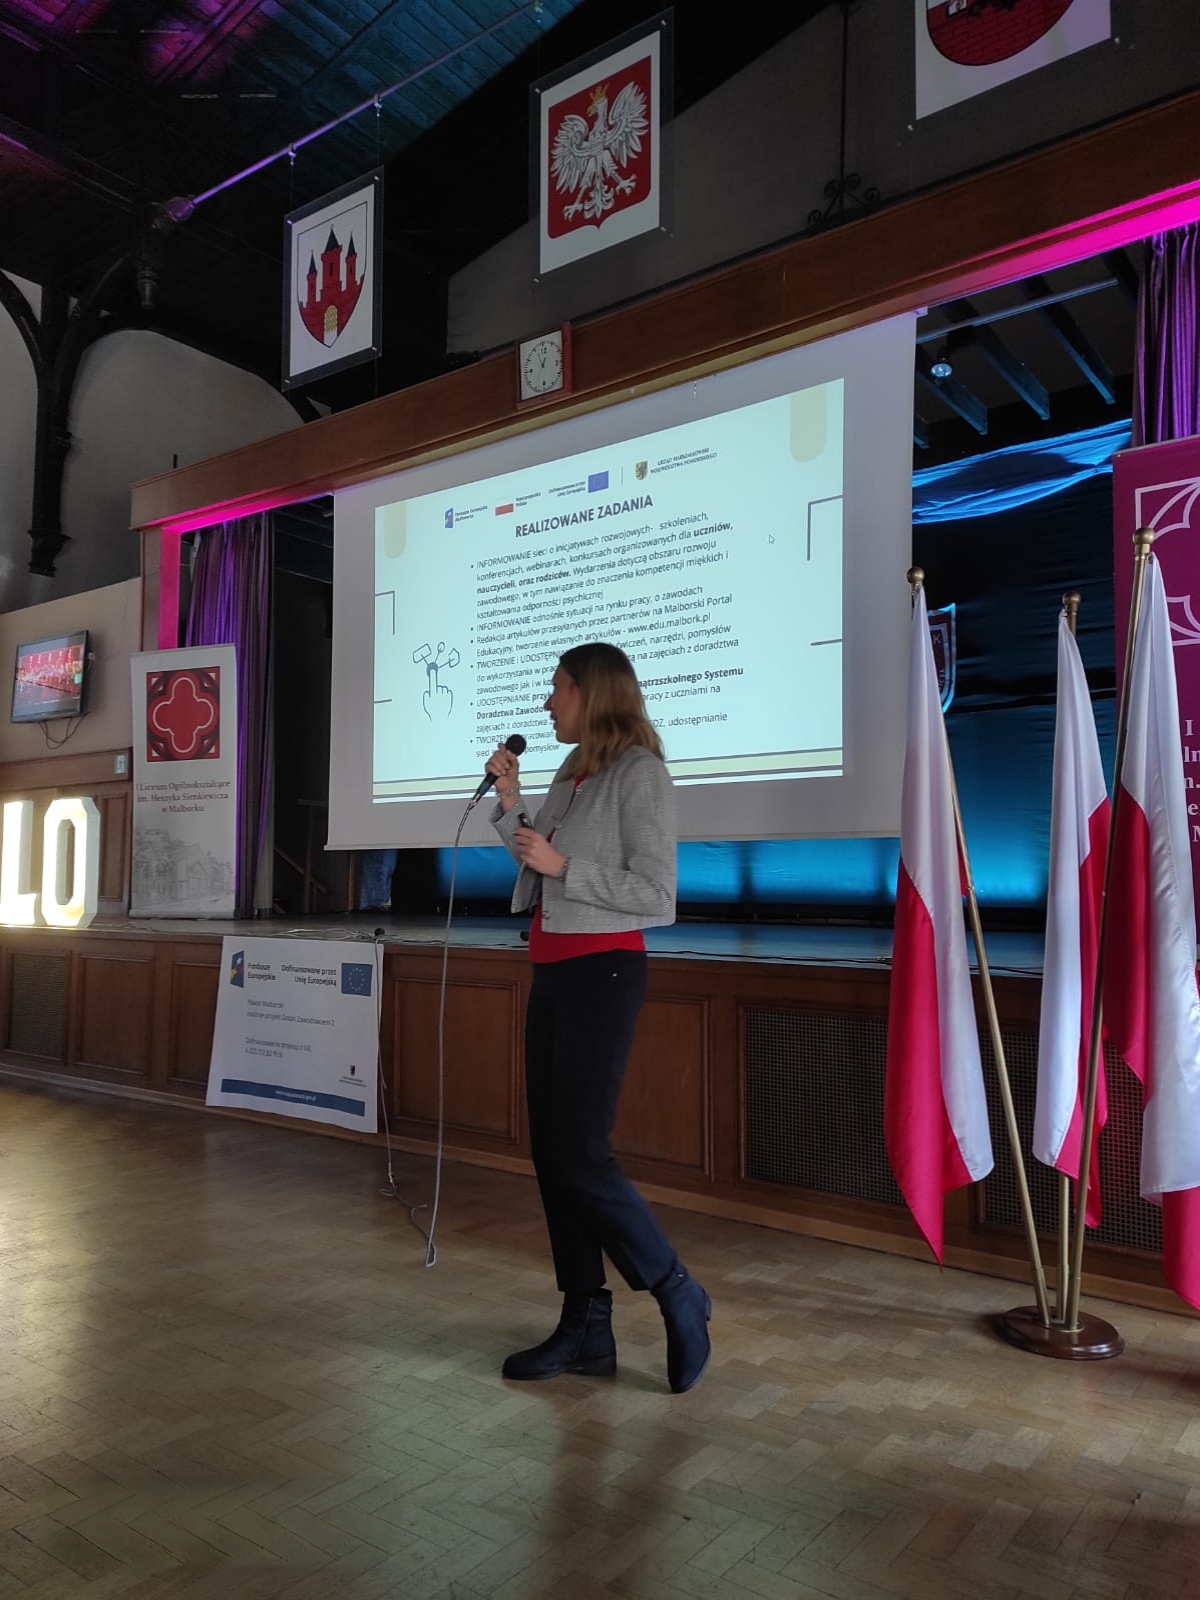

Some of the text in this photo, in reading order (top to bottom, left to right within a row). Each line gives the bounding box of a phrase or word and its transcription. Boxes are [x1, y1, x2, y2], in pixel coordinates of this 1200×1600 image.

[515, 495, 653, 538] REALIZOWANE ZADANIA
[477, 550, 531, 569] INFORMOWANIE
[532, 547, 548, 557] sieci
[555, 536, 599, 553] inicjatywach
[659, 511, 709, 531] szkoleniach,
[477, 521, 733, 582] konferencjach, webinarach, konkursach organizowanych dla uczniów,
[477, 540, 717, 594] nauczycieli, oraz rodziców. Wydarzenia dotyczą obszaru rozwoju
[530, 589, 543, 599] tym
[544, 579, 584, 594] nawiązanie
[585, 577, 595, 587] do
[597, 570, 634, 585] znaczenia
[635, 559, 685, 577] kompetencji
[686, 552, 724, 568] miękkich
[477, 589, 604, 619] kształtowania odporności psychicznej
[477, 615, 531, 632] INFORMOWANIE
[532, 611, 565, 623] odnośnie
[566, 607, 593, 620] sytuacji
[606, 600, 628, 612] rynku
[661, 585, 703, 601] zawodach
[477, 593, 733, 644] Redakcja artykułów przesyłanych przez partnerów na Malborski Portal
[477, 658, 516, 671] TWORZENIE
[520, 650, 568, 664] UDOSTĘPNI
[649, 631, 686, 645] narzędzi,
[688, 625, 732, 641] pomysłów
[515, 639, 549, 651] tworzenie
[550, 633, 584, 646] własnych
[584, 627, 621, 643] artykułów
[627, 612, 711, 634] www.edu.malbork.pl
[486, 668, 533, 682] wykorzystania
[637, 652, 648, 661] na
[649, 645, 686, 660] zajęciach
[687, 646, 692, 654] z
[693, 639, 739, 653] doradztwa
[476, 693, 531, 707] UDOSTĘPNIANIE
[638, 671, 702, 689] nątrzszkolnego
[704, 667, 744, 682] Systemu
[476, 683, 519, 695] zawodowego
[520, 681, 530, 692] jak
[476, 709, 514, 720] Doradztwa
[671, 685, 708, 698] uczniami
[710, 685, 721, 693] na
[476, 722, 506, 733] zajęciach
[512, 718, 548, 729] doradztwa
[476, 734, 510, 745] TWORZEN
[525, 730, 555, 740] racowań
[668, 712, 728, 727] udostępnianie
[1185, 719, 1195, 736] I
[476, 747, 489, 757] sieci
[140, 783, 168, 791] Liceum
[169, 780, 231, 791] Ogólnokształcące
[151, 793, 180, 803] Henryka
[182, 792, 228, 801] Sienkiewicza
[169, 804, 204, 813] Malborku
[248, 962, 271, 971] Fundusze
[248, 972, 276, 981] Europejskie
[281, 964, 320, 975] Dofinansowane
[294, 975, 337, 987] Unię Europejską
